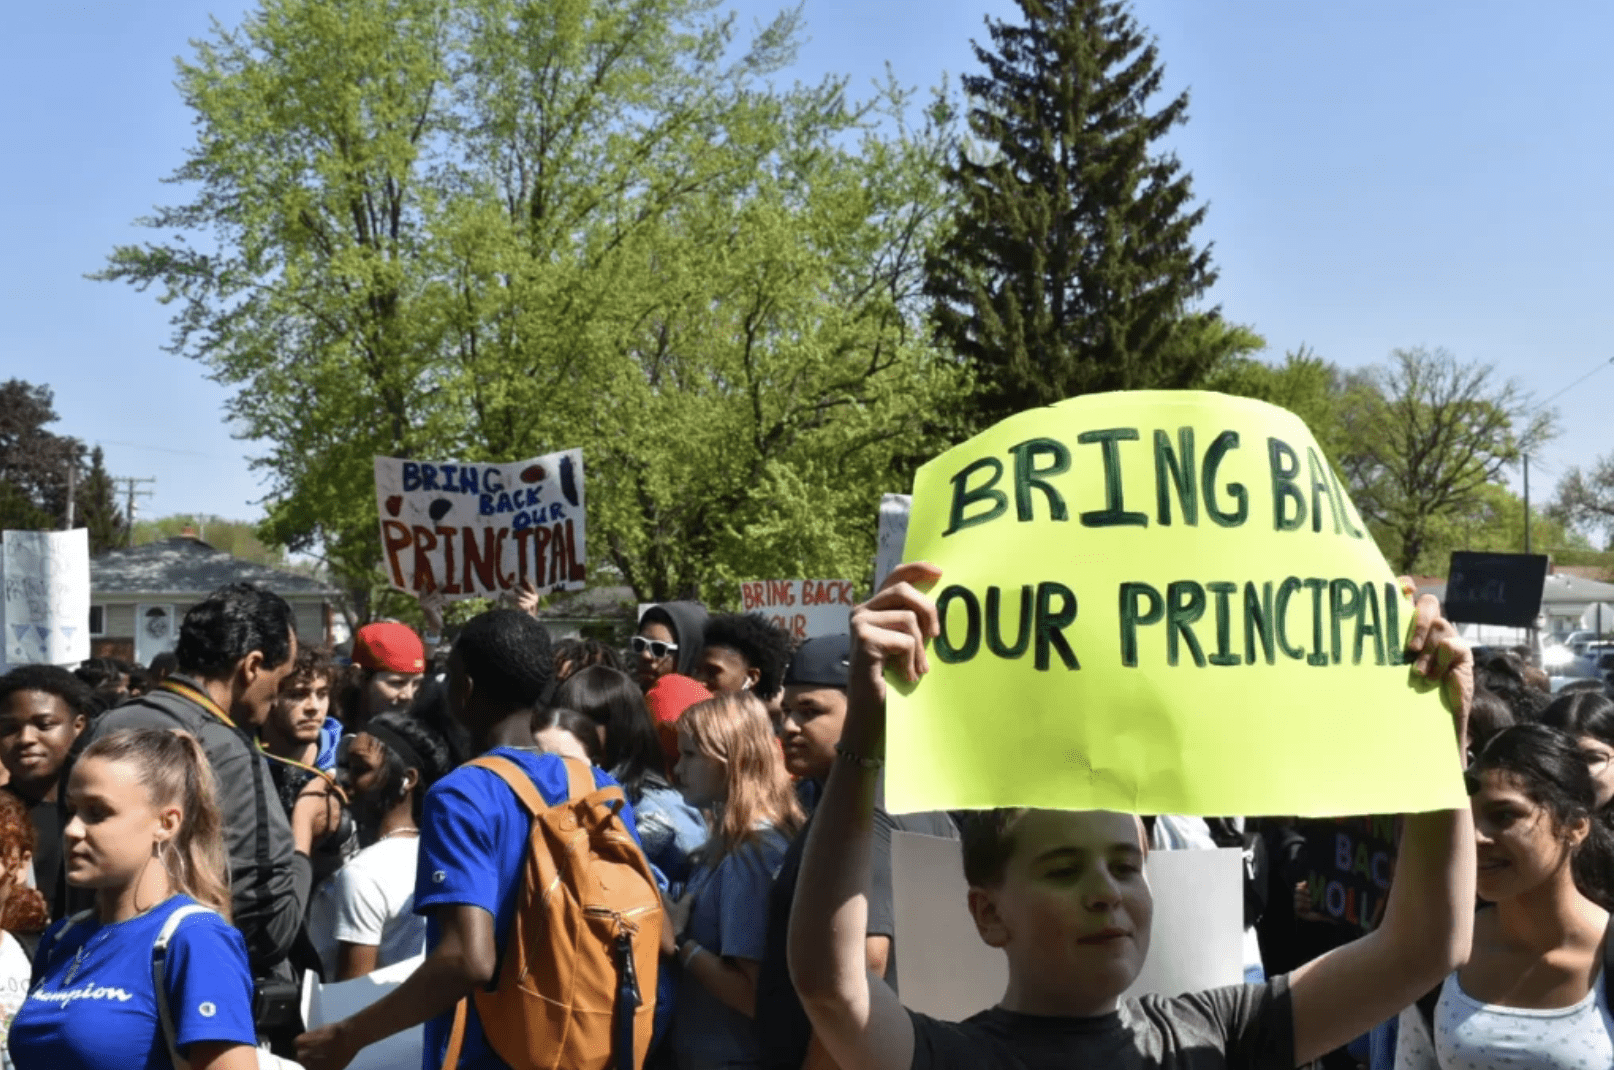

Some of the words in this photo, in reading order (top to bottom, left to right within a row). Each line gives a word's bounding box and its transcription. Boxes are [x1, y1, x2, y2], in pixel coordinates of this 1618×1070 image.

[403, 462, 504, 495] BRING
[942, 426, 1249, 537] BRING
[1267, 436, 1364, 539] BAC
[479, 485, 543, 515] BACK
[512, 502, 566, 531] OUR
[382, 518, 586, 594] PRINCIPAL
[742, 580, 796, 610] BRING
[802, 580, 853, 606] BACK
[934, 582, 1081, 671] OUR
[1119, 576, 1412, 669] PRINCIPAL
[1335, 833, 1391, 889] BAC
[30, 977, 133, 1009] hampion
